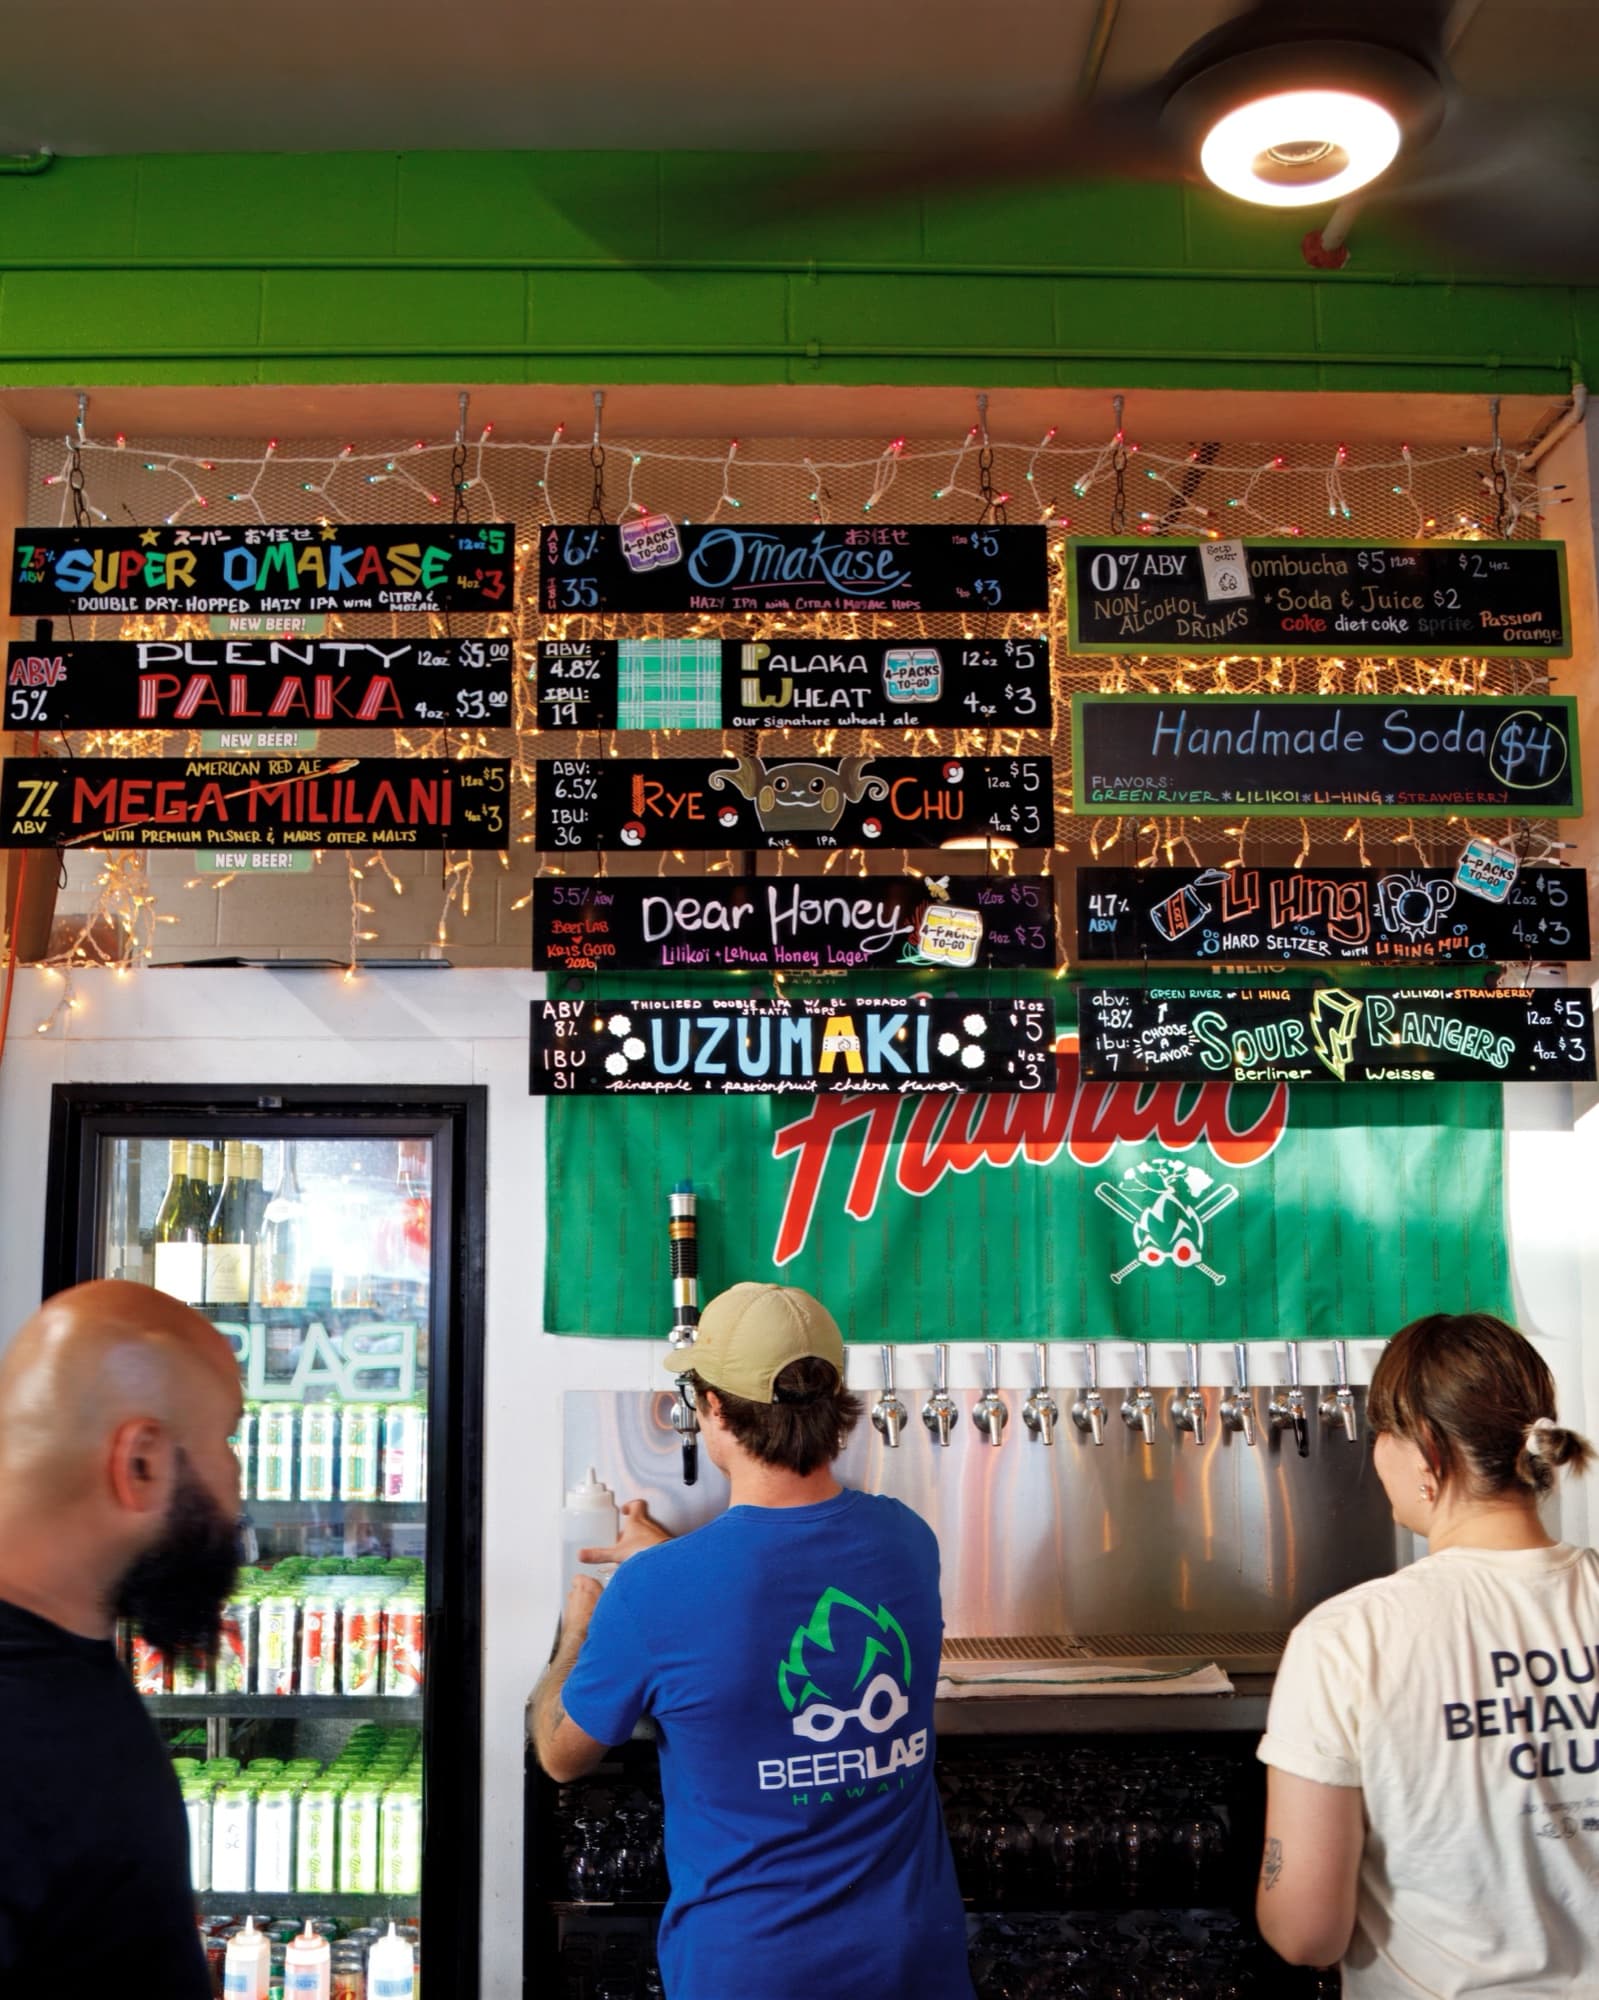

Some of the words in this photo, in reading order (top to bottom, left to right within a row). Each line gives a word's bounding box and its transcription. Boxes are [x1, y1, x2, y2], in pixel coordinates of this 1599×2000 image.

[174, 530, 231, 546] スーパー
[479, 529, 505, 554] $5
[623, 528, 685, 554] 4-PACKS
[844, 529, 910, 545] お任せ
[563, 529, 599, 566] 6%
[638, 546, 669, 560] TO-GO
[55, 548, 197, 594] SUPER
[223, 542, 453, 594] OMAKASE
[688, 528, 911, 596] Omakase
[1250, 553, 1348, 577] ombucha
[1357, 551, 1385, 575] $5
[1458, 553, 1488, 578] $2
[20, 571, 45, 583] ABV
[1091, 553, 1140, 592] 0%
[1143, 554, 1187, 576] ABV
[379, 592, 422, 604] CITRA
[561, 577, 598, 607] 35
[974, 579, 1001, 606] $3
[1276, 586, 1332, 612] Soda
[1360, 585, 1425, 613] Juice
[1432, 587, 1462, 610] $2
[78, 597, 139, 612] DOUBLE
[145, 596, 250, 613] DRY-HOPPED
[261, 597, 302, 612] HAZY
[310, 598, 338, 610] IPA
[344, 598, 372, 609] WITH
[690, 596, 725, 609] HAZY
[733, 597, 757, 609] IPA
[229, 618, 262, 632] NEW
[265, 618, 306, 632] BEER!
[1119, 596, 1206, 636] ALCOHOL
[1175, 607, 1249, 638] DRINKS
[1280, 613, 1328, 633] coke
[1334, 613, 1368, 632] diet
[1371, 613, 1409, 633] coke
[1480, 610, 1543, 628] Passion
[136, 642, 412, 670] PLENTY
[417, 651, 450, 667] 12oz
[545, 642, 591, 656] ABV:
[741, 643, 869, 673] PALAKA
[962, 651, 998, 668] 12oz
[1004, 640, 1035, 670] $5
[9, 656, 67, 687] ABV:
[550, 659, 601, 680] 4.8%
[885, 664, 940, 680] 4-PACKS
[741, 677, 871, 708] WHEAT
[897, 677, 930, 689] TO-GO
[139, 674, 405, 721] PALAKA
[543, 687, 590, 701] IBU:
[963, 691, 997, 715] 4oz
[1004, 683, 1036, 715] $3
[11, 690, 48, 721] 5%
[414, 701, 444, 719] 4oz
[552, 702, 578, 726] 19
[838, 711, 886, 727] wheat
[893, 711, 919, 726] ale
[221, 734, 253, 748] NEW
[257, 734, 298, 748] BEER!
[1151, 709, 1365, 757] Handmade
[1382, 708, 1487, 757] Soda
[1499, 721, 1552, 782] $4
[186, 761, 260, 777] AMERICAN
[268, 760, 292, 775] RED
[297, 760, 322, 775] ALE
[552, 761, 591, 776] ABV:
[988, 777, 1011, 789] 12oz
[1010, 761, 1040, 792] $5
[483, 767, 504, 792] $5
[553, 777, 598, 800] 6.5%
[1091, 776, 1175, 789] FLAVORS:
[18, 780, 59, 818] 7%
[73, 777, 229, 823] MEGA
[248, 778, 453, 826] MILILANI
[1091, 789, 1153, 801] GREEN
[1158, 789, 1220, 802] RIVER
[1235, 790, 1299, 804] LILIKOI
[1313, 791, 1382, 804] LI-HING
[1397, 790, 1509, 804] STRAWBERRY
[551, 808, 590, 824] IBU:
[988, 812, 1012, 832] 4oz
[1010, 804, 1040, 834] $3
[13, 821, 48, 834] ABV
[103, 830, 135, 842] WITH
[142, 829, 203, 843] PREMIUM
[208, 829, 263, 843] PILSNER
[283, 830, 321, 843] MARIS
[327, 830, 368, 843] OTTER
[372, 830, 417, 843] MALTS
[554, 826, 582, 846] 36
[216, 854, 246, 868] NEW
[252, 854, 293, 868] BEER!
[1460, 854, 1515, 881] 4-PACKS
[1469, 867, 1500, 887] TO-GO
[1011, 884, 1041, 908] $5
[1535, 873, 1569, 907] $5
[1089, 893, 1130, 917] 4.7%
[642, 896, 753, 943] Dear
[766, 883, 914, 953] Honey
[1088, 918, 1118, 933] ABV
[1015, 927, 1047, 949] $3
[1511, 919, 1540, 944] 4oz
[1537, 917, 1571, 945] $3
[932, 938, 965, 950] TO-GO
[1222, 933, 1259, 951] HARD
[1266, 934, 1332, 956] SELTZER
[1376, 940, 1391, 954] LI
[1393, 941, 1435, 957] HING
[724, 946, 767, 963] Lehua
[775, 945, 819, 967] Honey
[827, 945, 869, 966] Lager
[1092, 990, 1129, 1007] abv:
[1150, 989, 1185, 1000] GREEN
[1189, 989, 1222, 1000] RIVER
[1241, 989, 1252, 1000] LI
[1258, 989, 1291, 1001] HING
[1400, 988, 1445, 1000] LILIKOI
[1453, 988, 1535, 1000] STRAWBERRY
[542, 1000, 585, 1020] ABV
[631, 1000, 702, 1010] THIOLIZED
[712, 1000, 756, 1009] DOUBLE
[770, 1000, 791, 1008] IPA
[856, 999, 908, 1007] DORADO
[805, 1007, 836, 1016] HOPS
[1013, 1000, 1045, 1012] 12oz
[1526, 1012, 1553, 1027] 12oz
[1554, 1000, 1589, 1029] $5
[554, 1021, 578, 1037] 8%
[1141, 1023, 1188, 1046] CHOOSE
[1191, 1010, 1309, 1071] SOUR
[1365, 995, 1516, 1069] RANGERS
[651, 1014, 931, 1077] UZUMAKI
[1096, 1033, 1130, 1051] ibu:
[1160, 1037, 1170, 1050] A
[1533, 1041, 1563, 1060] 4oz
[1559, 1036, 1591, 1062] $3
[545, 1050, 586, 1070] IBU
[1018, 1050, 1046, 1063] 4oz
[1105, 1053, 1119, 1072] 7
[1144, 1044, 1193, 1064] FLAVOR
[554, 1072, 575, 1089] 31
[1234, 1067, 1313, 1081] Berliner
[1365, 1067, 1436, 1081] Weisse
[606, 1080, 692, 1095] pineapple
[1490, 1643, 1599, 1688] POU
[758, 1728, 928, 1790] BEERLAB
